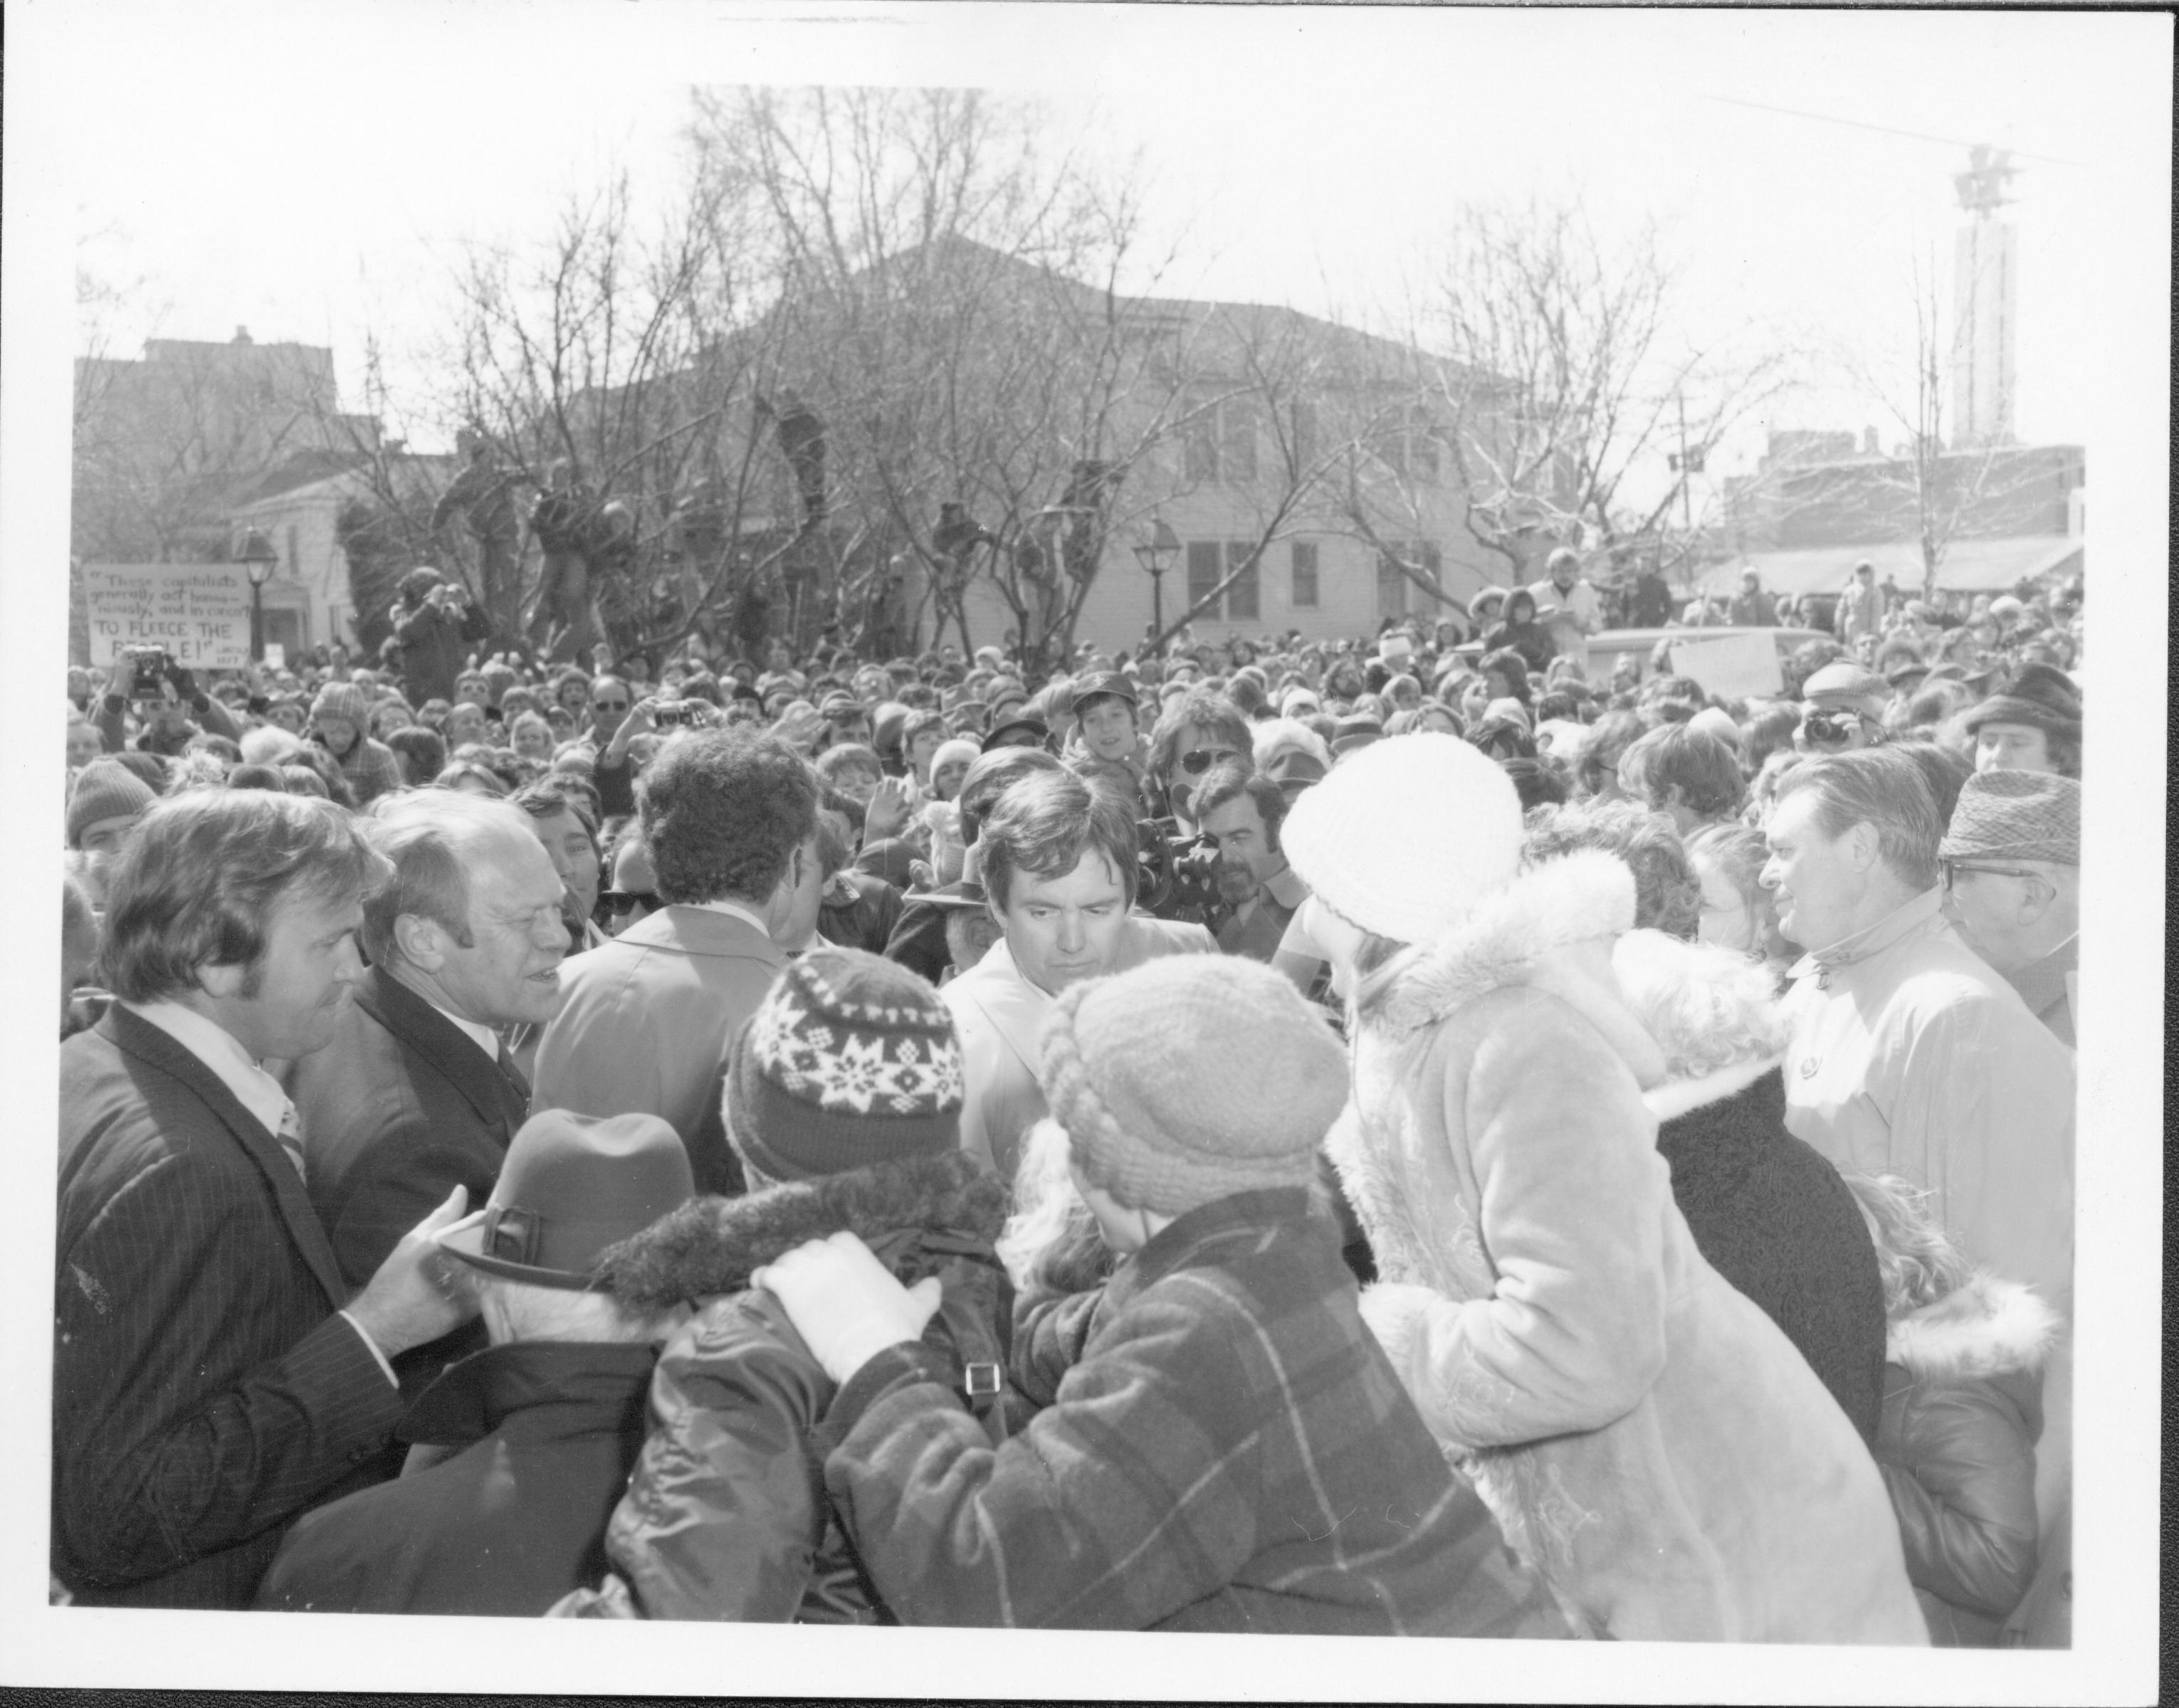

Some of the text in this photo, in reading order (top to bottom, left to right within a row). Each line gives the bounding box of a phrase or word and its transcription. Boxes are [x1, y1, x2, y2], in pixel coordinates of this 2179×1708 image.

[90, 589, 154, 605] generally
[161, 586, 184, 600] act
[160, 603, 184, 614] and
[94, 621, 232, 639] TO FLEECE THE
